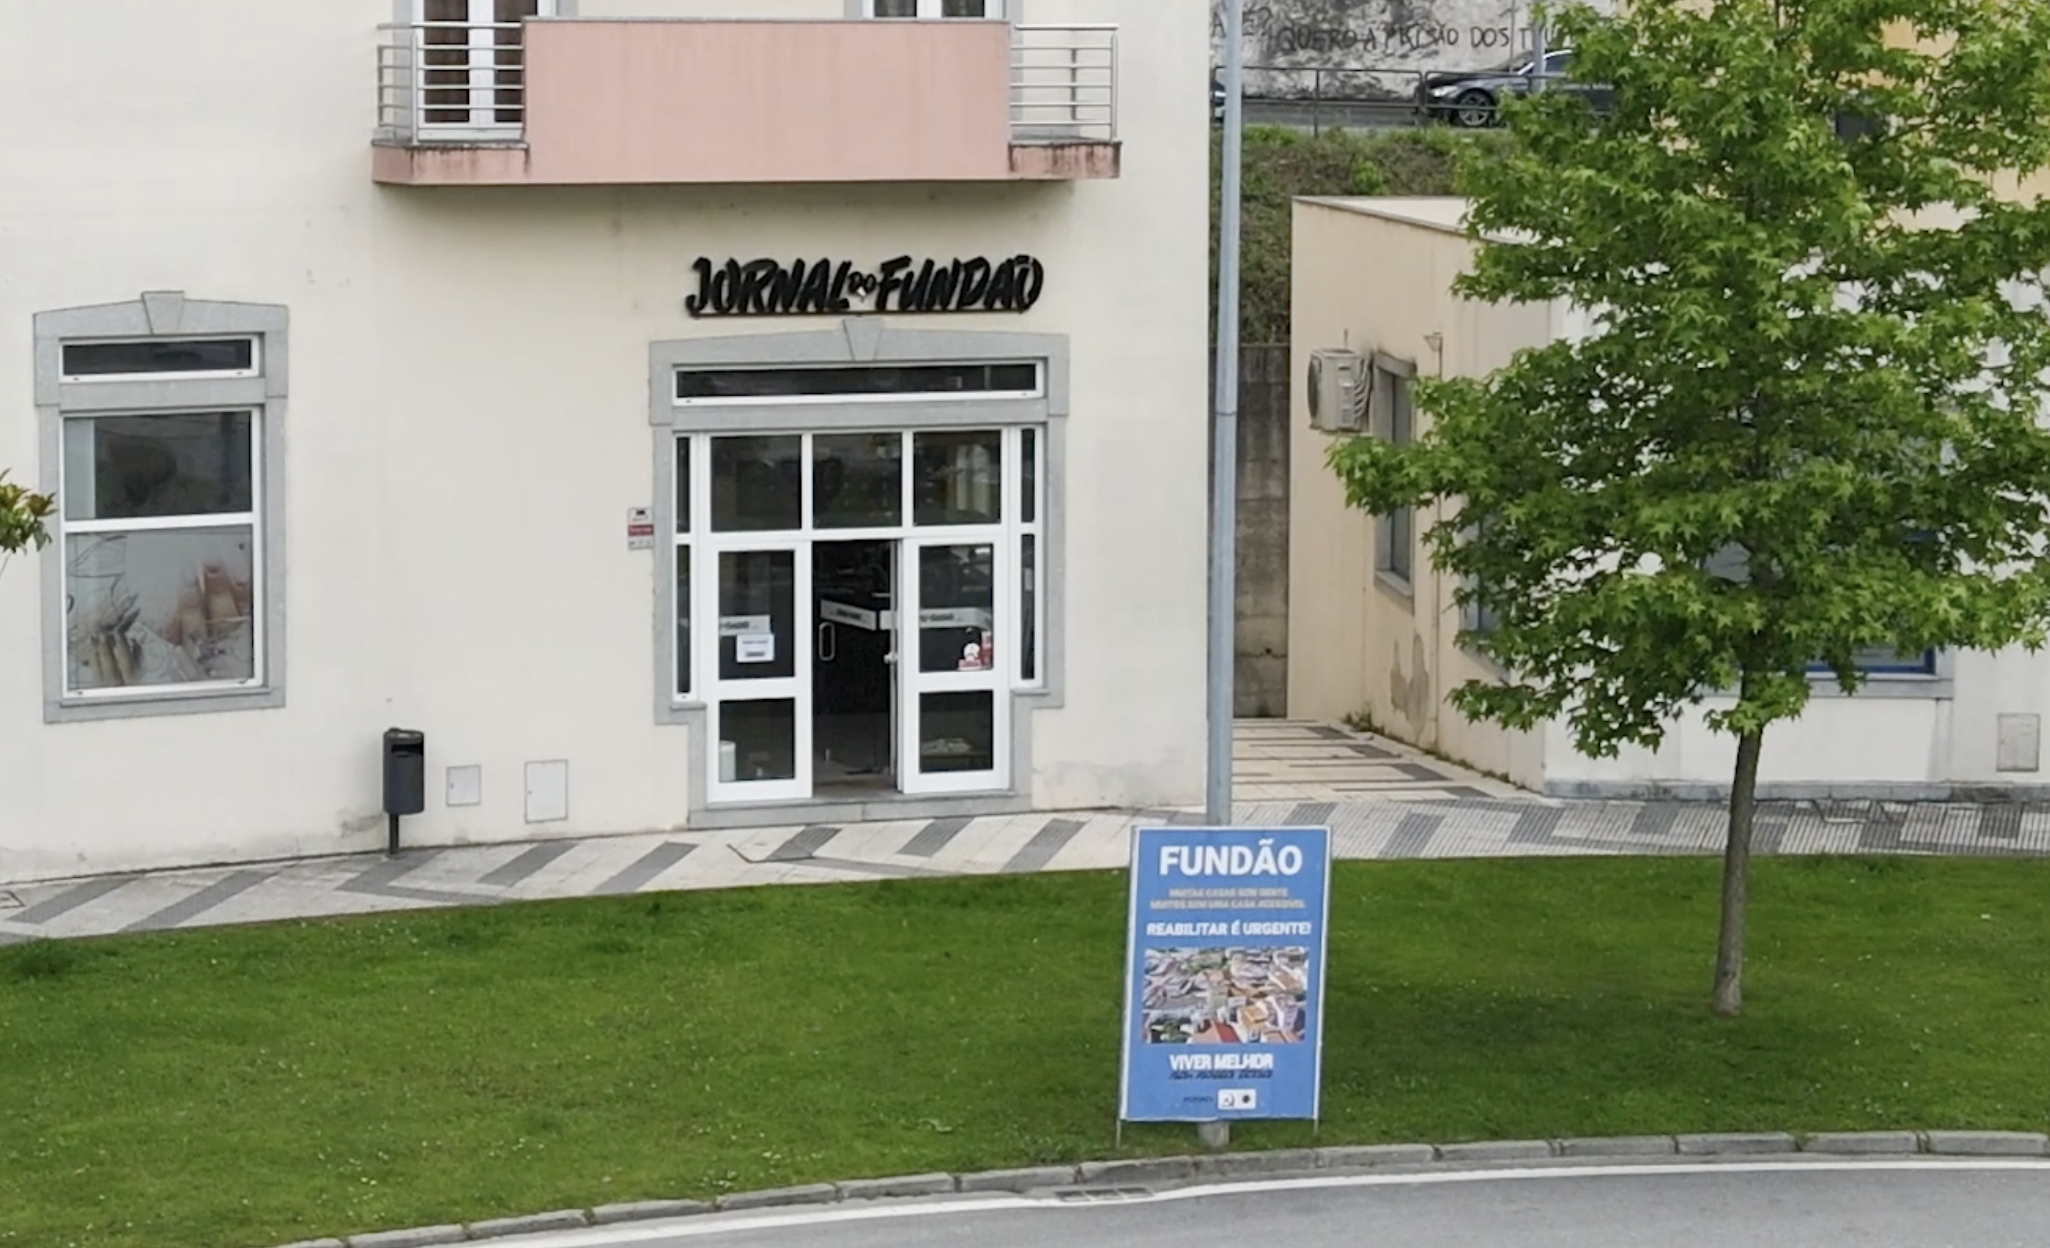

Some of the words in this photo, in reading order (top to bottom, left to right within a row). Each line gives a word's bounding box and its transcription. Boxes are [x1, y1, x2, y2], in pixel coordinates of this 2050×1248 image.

[1470, 26, 1510, 47] DOS
[686, 257, 852, 314] JORNAL
[848, 271, 876, 296] DO
[874, 254, 1044, 314] FUNDÃO
[1159, 838, 1303, 876] FUNDÃO
[1146, 922, 1228, 936] REABILITAR
[1231, 919, 1241, 935] É
[1242, 920, 1312, 936] URGENTE!
[1169, 1053, 1212, 1071] VIVER
[1214, 1052, 1274, 1070] MELHOR
